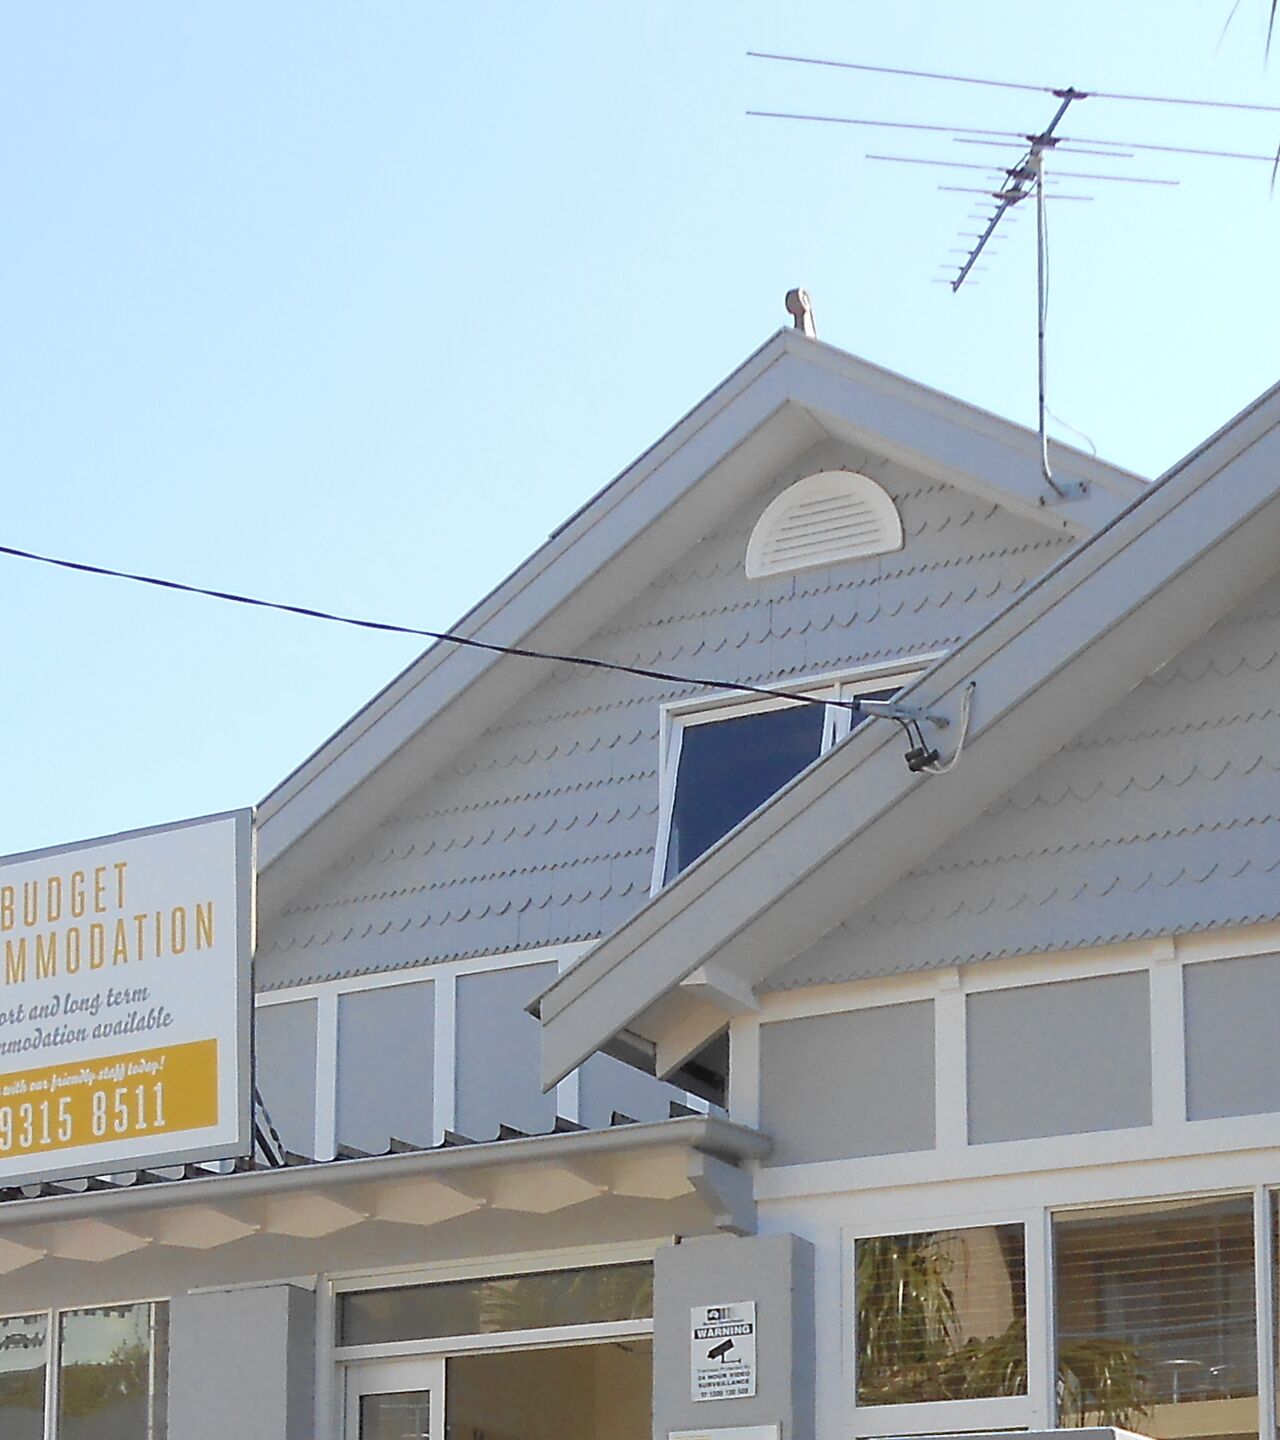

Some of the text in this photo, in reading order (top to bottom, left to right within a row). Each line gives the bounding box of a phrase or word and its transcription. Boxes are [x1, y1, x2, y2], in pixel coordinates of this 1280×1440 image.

[0, 862, 128, 933] BUDGET
[28, 994, 61, 1021] and
[63, 992, 103, 1016] long
[106, 986, 150, 1008] term
[92, 1006, 174, 1040] available
[3, 1079, 28, 1097] with
[29, 1079, 48, 1092] our
[49, 1068, 96, 1092] friendly
[97, 1063, 127, 1082] staff
[92, 1081, 166, 1137] 8511
[696, 1324, 750, 1338] WARNING
